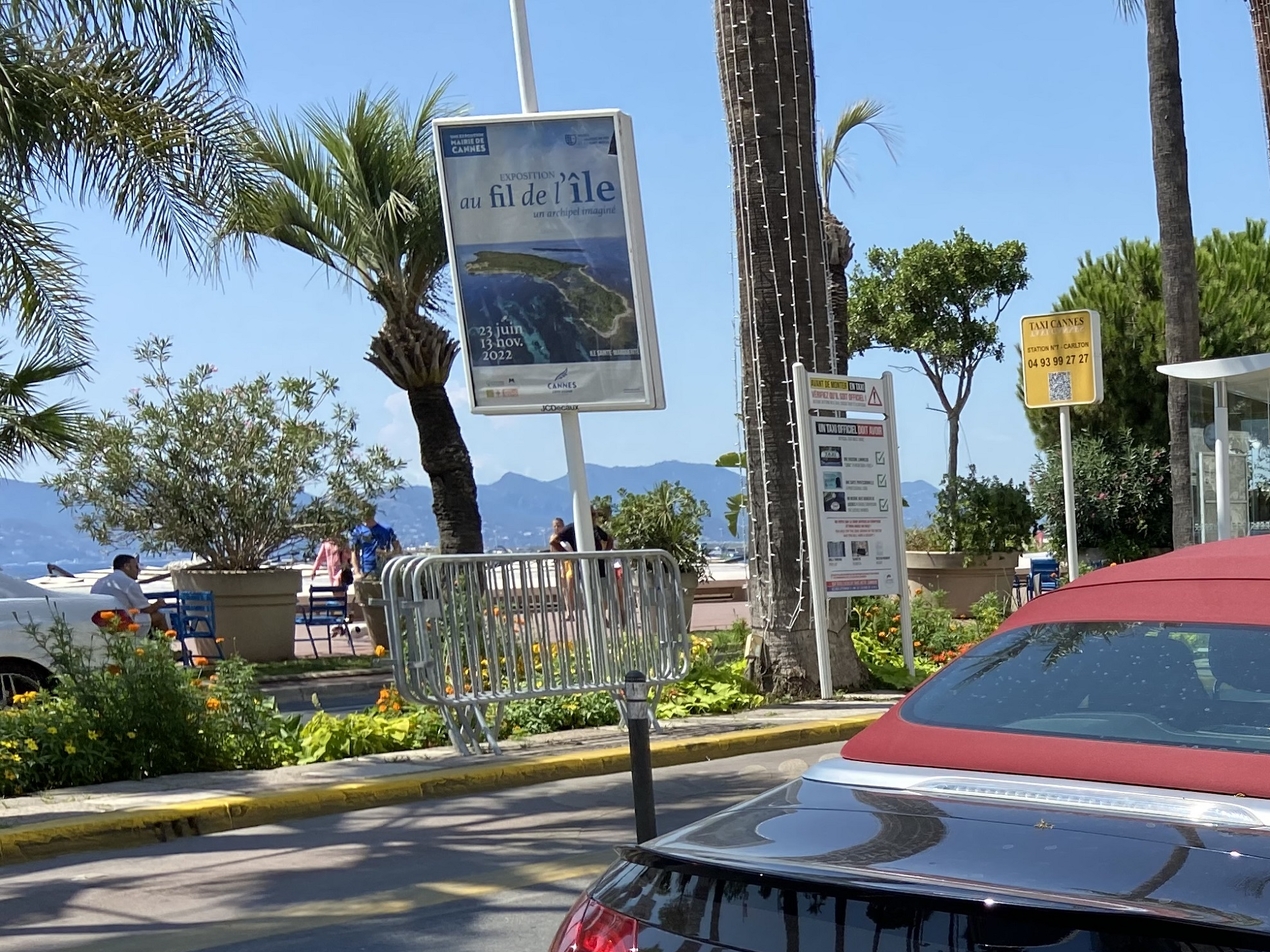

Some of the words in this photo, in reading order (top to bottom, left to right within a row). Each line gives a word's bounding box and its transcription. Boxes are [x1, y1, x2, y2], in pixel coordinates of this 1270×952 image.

[451, 138, 474, 146] MAIRIE
[452, 144, 486, 154] CANNES
[500, 171, 555, 181] EXPOSITION
[460, 197, 481, 209] au
[489, 184, 515, 208] fil
[521, 183, 547, 206] de
[555, 170, 616, 204] l'île
[547, 207, 580, 219] archipel
[582, 207, 616, 218] imaginé
[1030, 321, 1048, 331] TAXI
[1050, 317, 1084, 329] CANNES
[479, 326, 492, 337] 23
[496, 322, 523, 338] juin
[481, 338, 492, 349] 13
[497, 337, 523, 348] nov.
[1028, 345, 1049, 353] STATION
[482, 350, 512, 360] 2022
[1028, 359, 1038, 368] 04
[1040, 357, 1050, 367] 93
[1053, 356, 1063, 366] 99
[1066, 355, 1075, 365] 27
[1079, 354, 1088, 363] 27
[547, 381, 577, 390] CANNES
[838, 424, 857, 434] OFFICIEL
